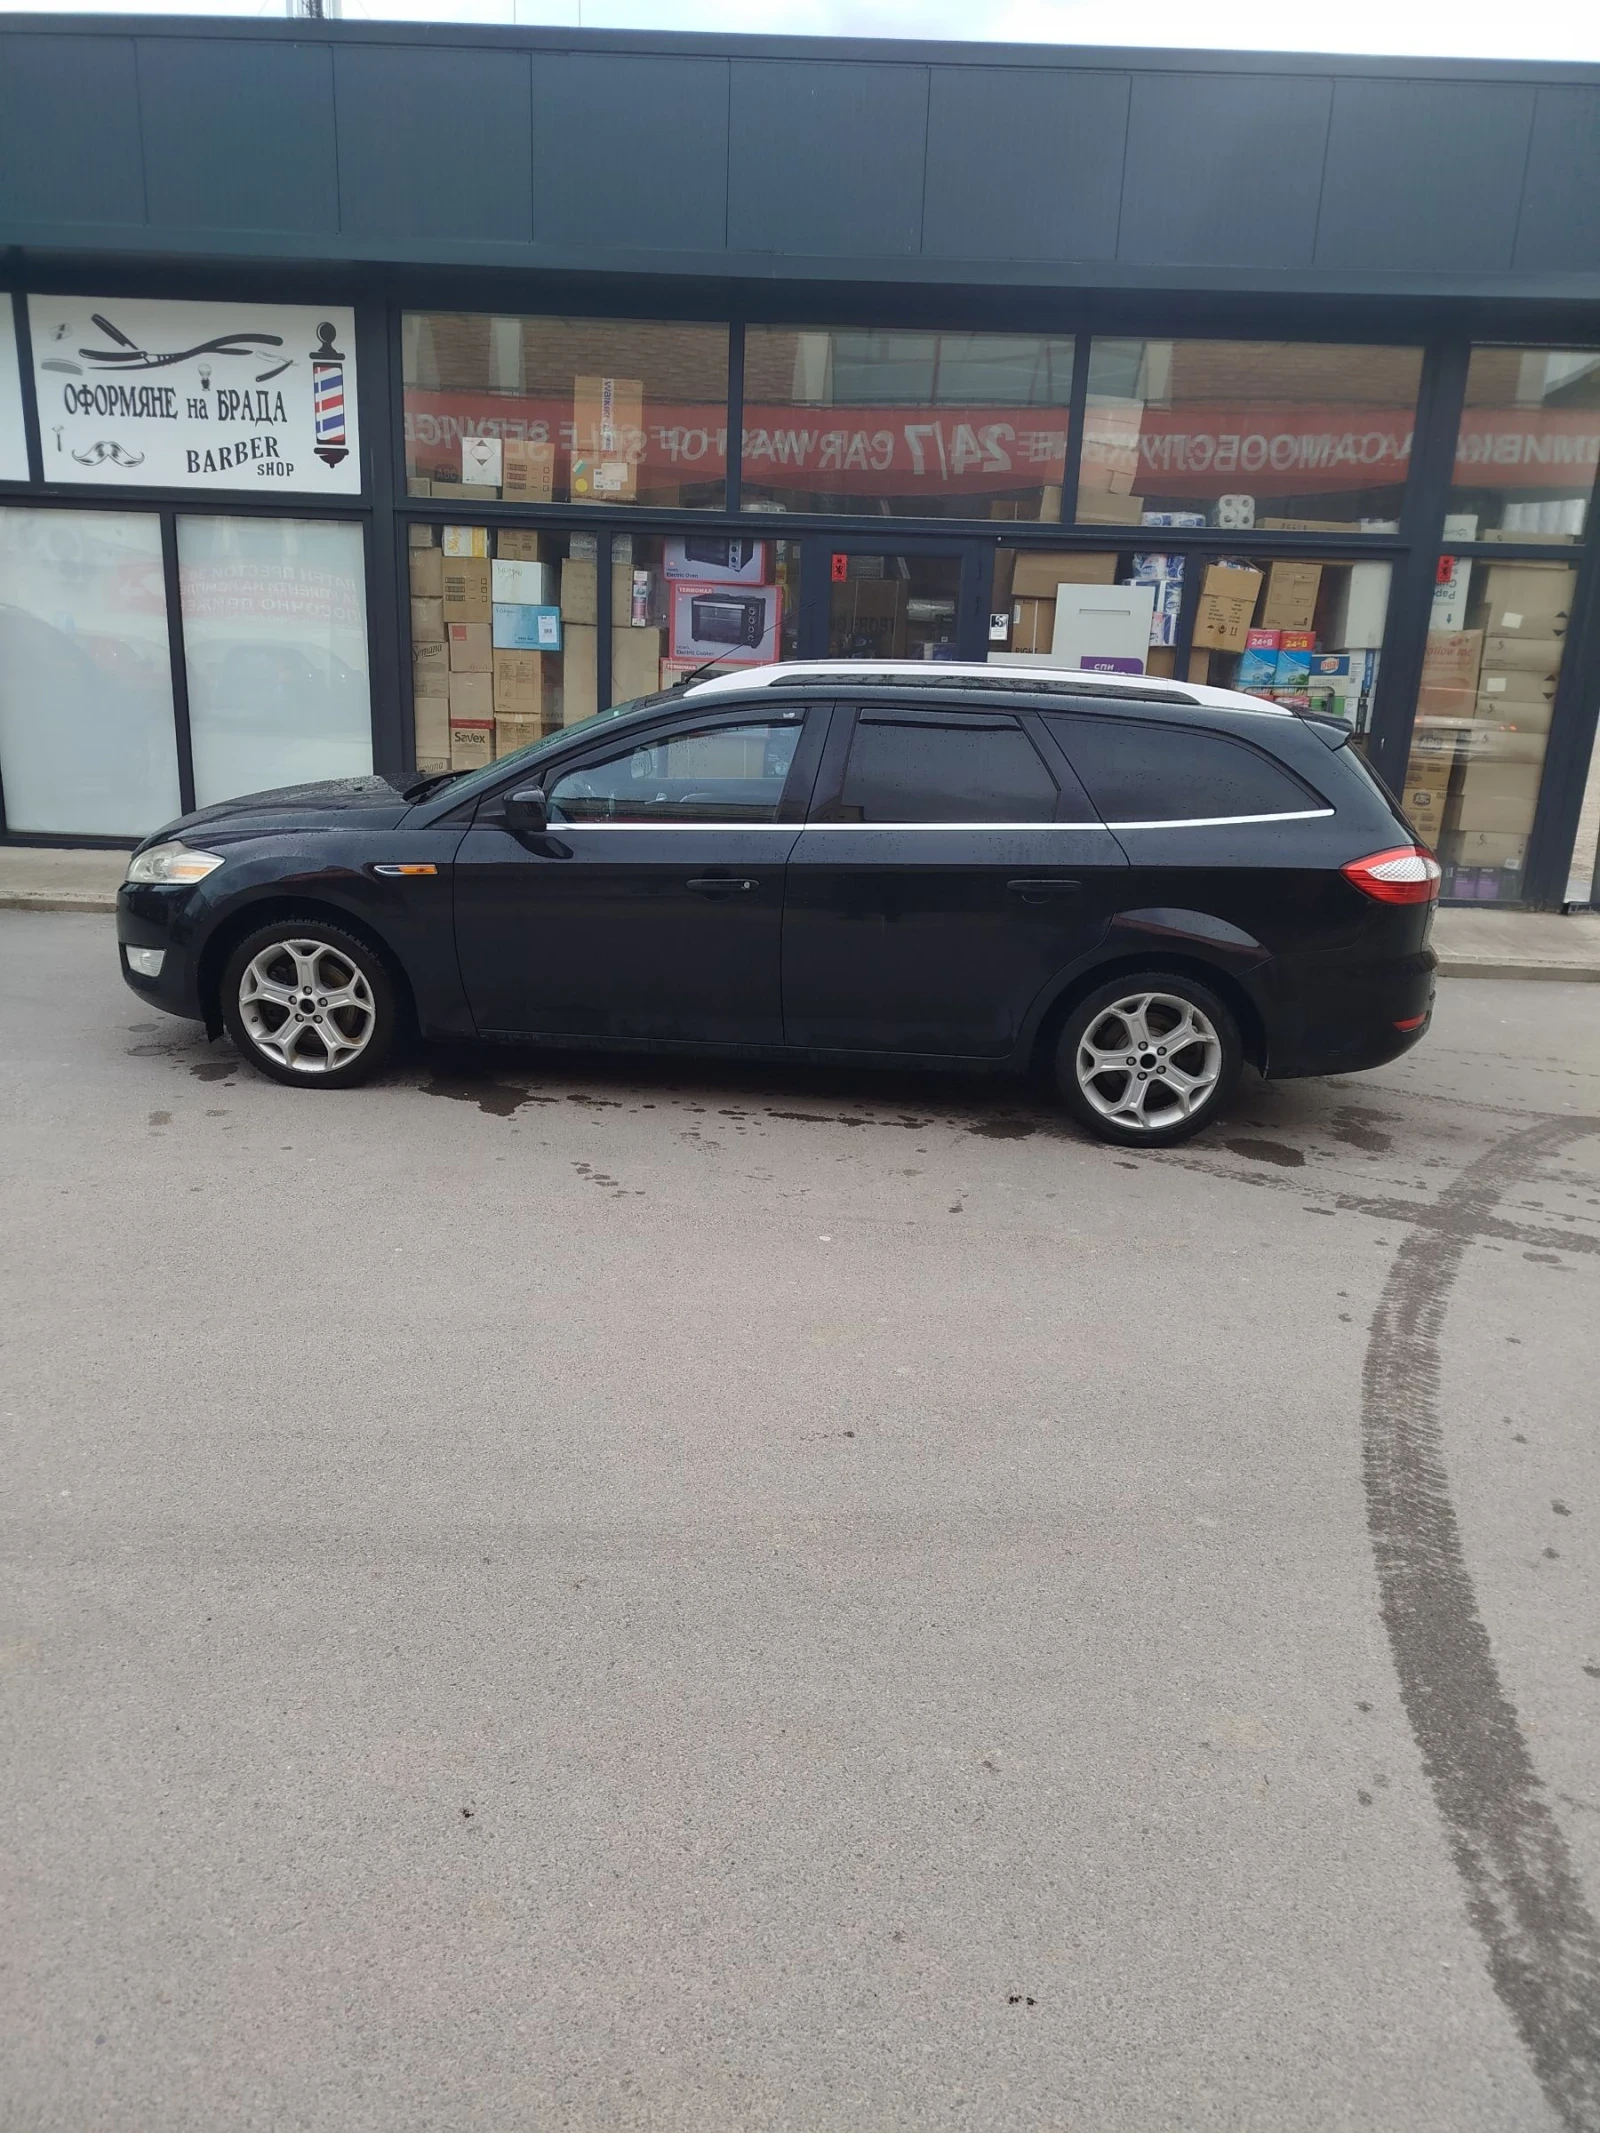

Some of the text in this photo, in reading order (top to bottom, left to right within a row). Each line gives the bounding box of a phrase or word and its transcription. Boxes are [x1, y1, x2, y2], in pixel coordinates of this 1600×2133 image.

[63, 383, 288, 427] ОФОРМЯНЕ на БРАДА
[186, 436, 280, 474] BARBER
[256, 461, 295, 477] SHOP
[411, 643, 443, 662] Semana
[454, 731, 486, 744] Savex
